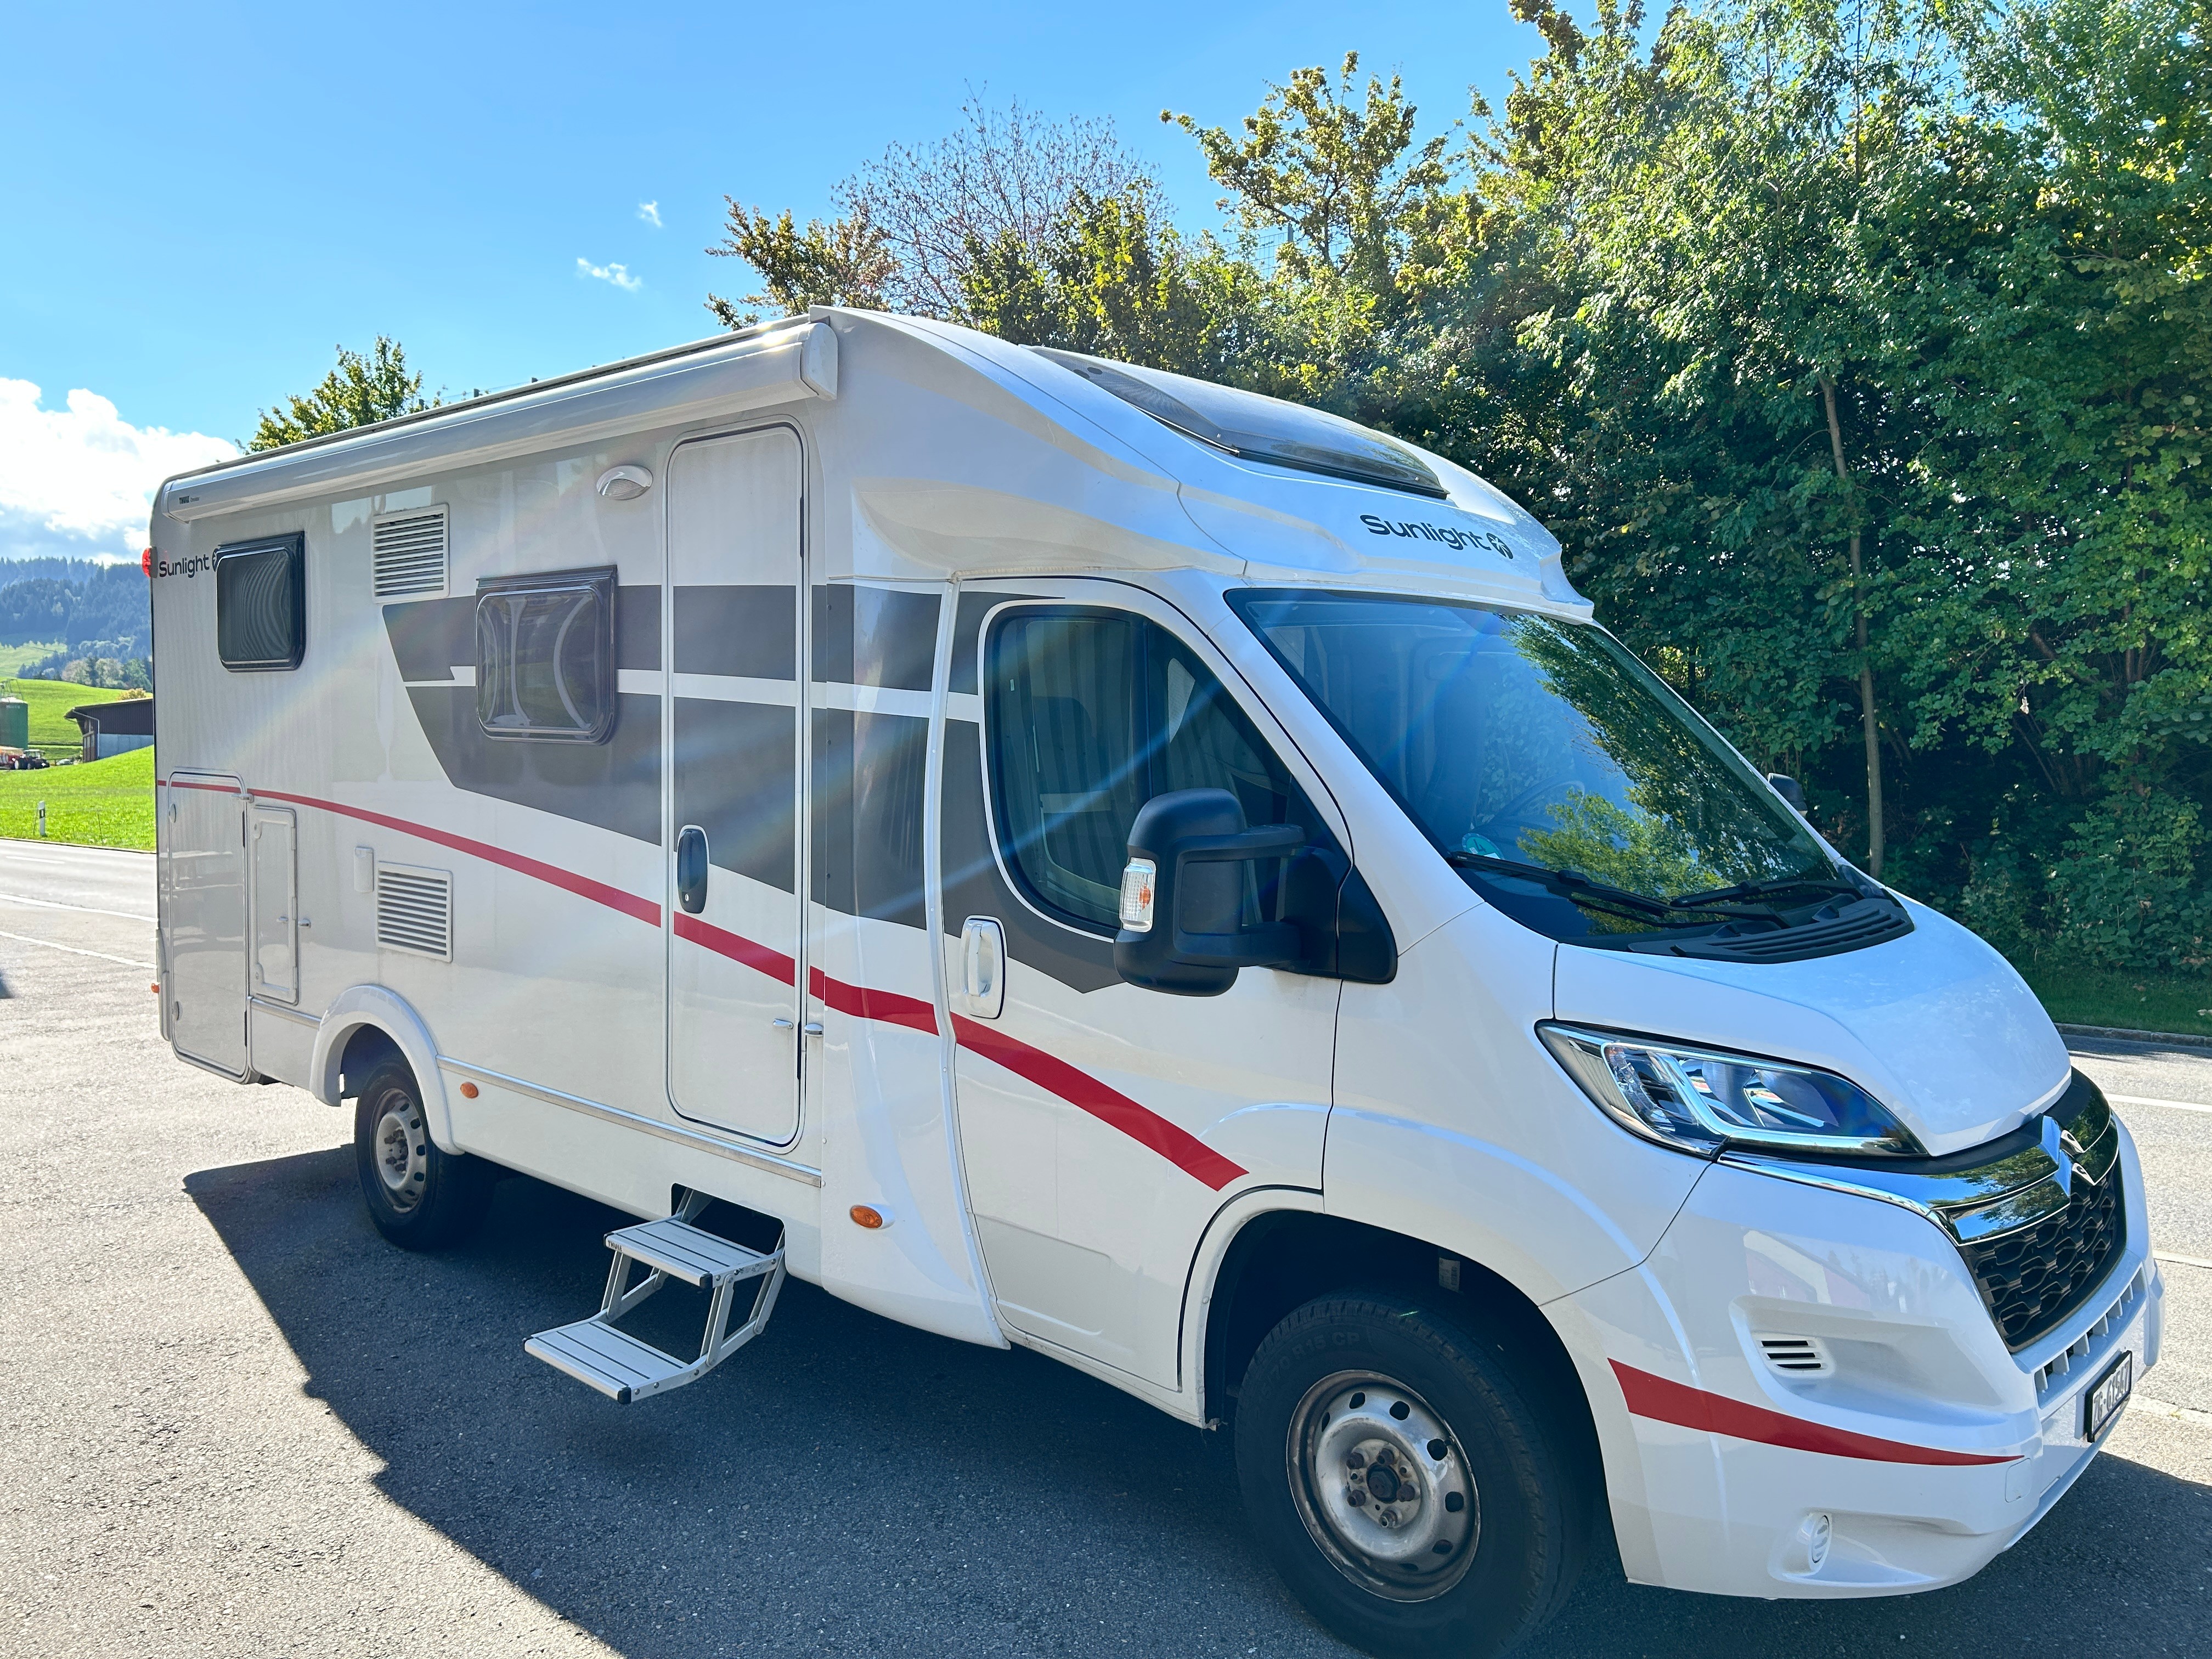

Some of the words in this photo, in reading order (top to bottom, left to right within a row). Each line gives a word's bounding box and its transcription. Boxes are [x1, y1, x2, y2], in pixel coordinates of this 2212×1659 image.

[1359, 514, 1492, 551] Sunlight
[159, 554, 210, 578] Sunlight
[608, 1240, 623, 1252] THULE
